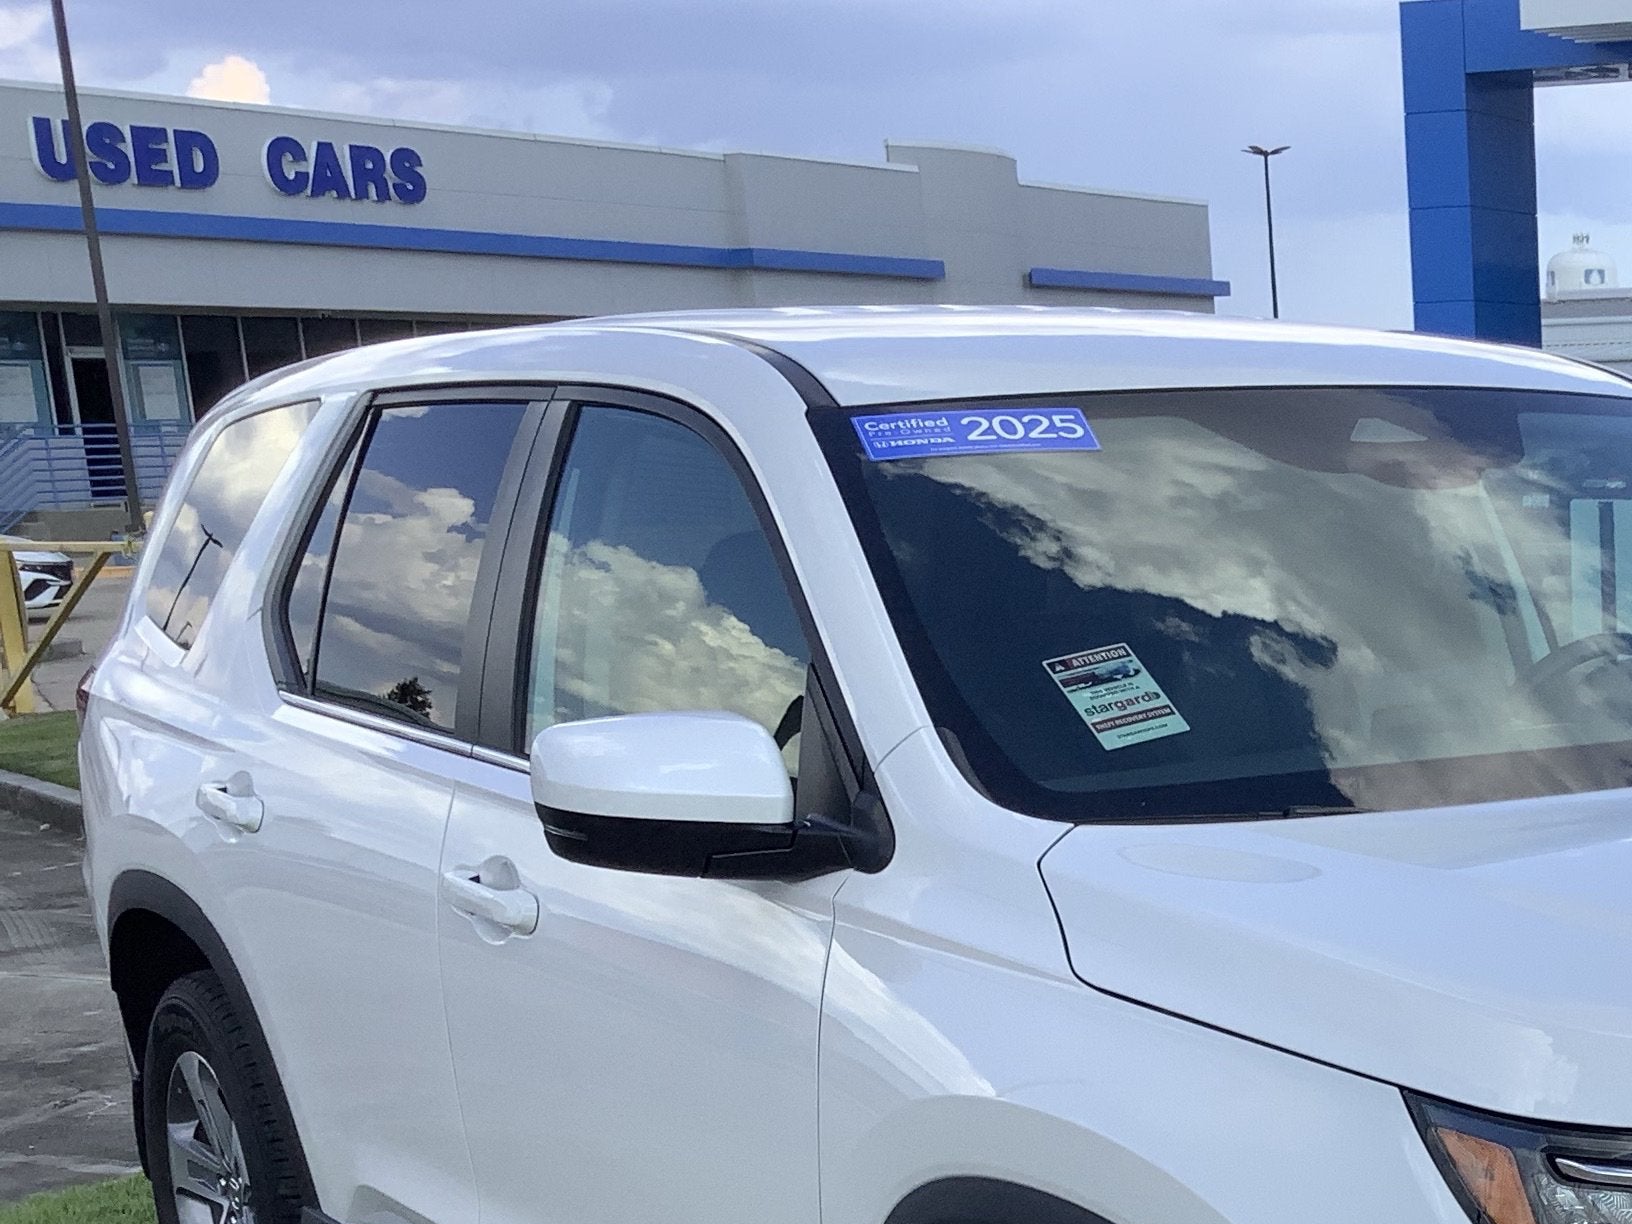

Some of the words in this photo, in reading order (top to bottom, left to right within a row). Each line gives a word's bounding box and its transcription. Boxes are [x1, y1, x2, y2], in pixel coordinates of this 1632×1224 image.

[30, 116, 220, 190] USED
[263, 136, 428, 205] CARS
[864, 416, 949, 432] Certified
[960, 414, 1085, 441] 2025
[890, 437, 956, 447] HONDA
[1072, 648, 1128, 668] ATTENTION
